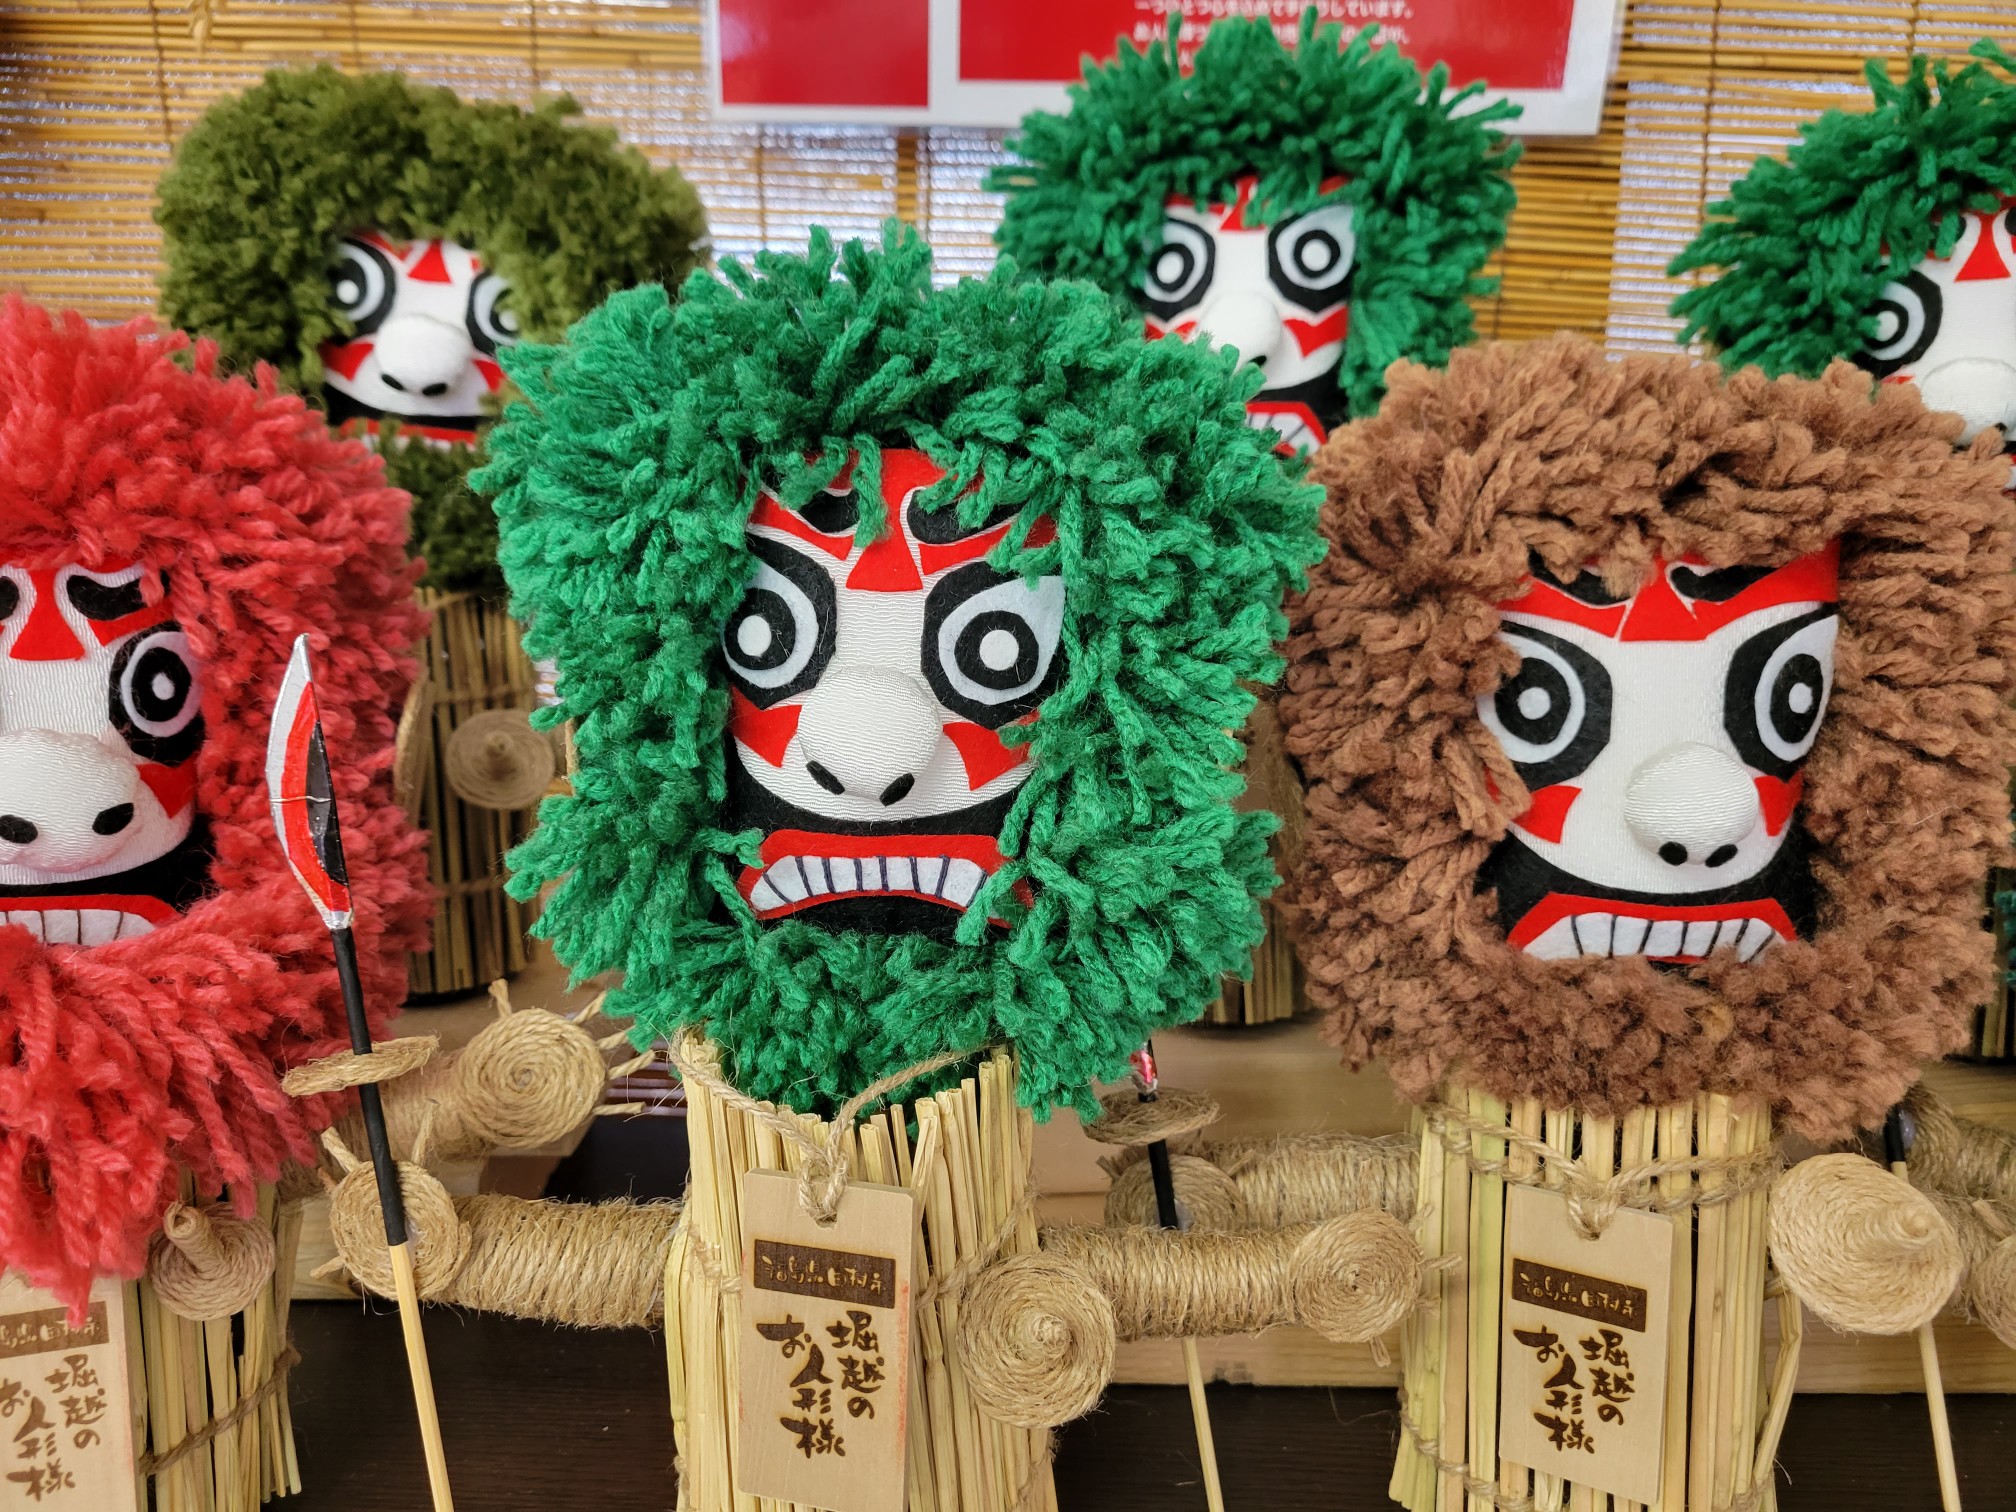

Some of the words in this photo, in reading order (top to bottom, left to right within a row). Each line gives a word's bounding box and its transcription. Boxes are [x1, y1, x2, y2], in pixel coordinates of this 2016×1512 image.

[761, 1255, 886, 1295] 福島県田村市
[1519, 1272, 1637, 1319] 福島県田村市
[44, 1354, 108, 1450] 堀越の
[756, 1313, 846, 1459] お人形様
[825, 1310, 886, 1420] 堀越の
[1513, 1325, 1595, 1454] お人形様
[1578, 1329, 1636, 1426] 堀越の
